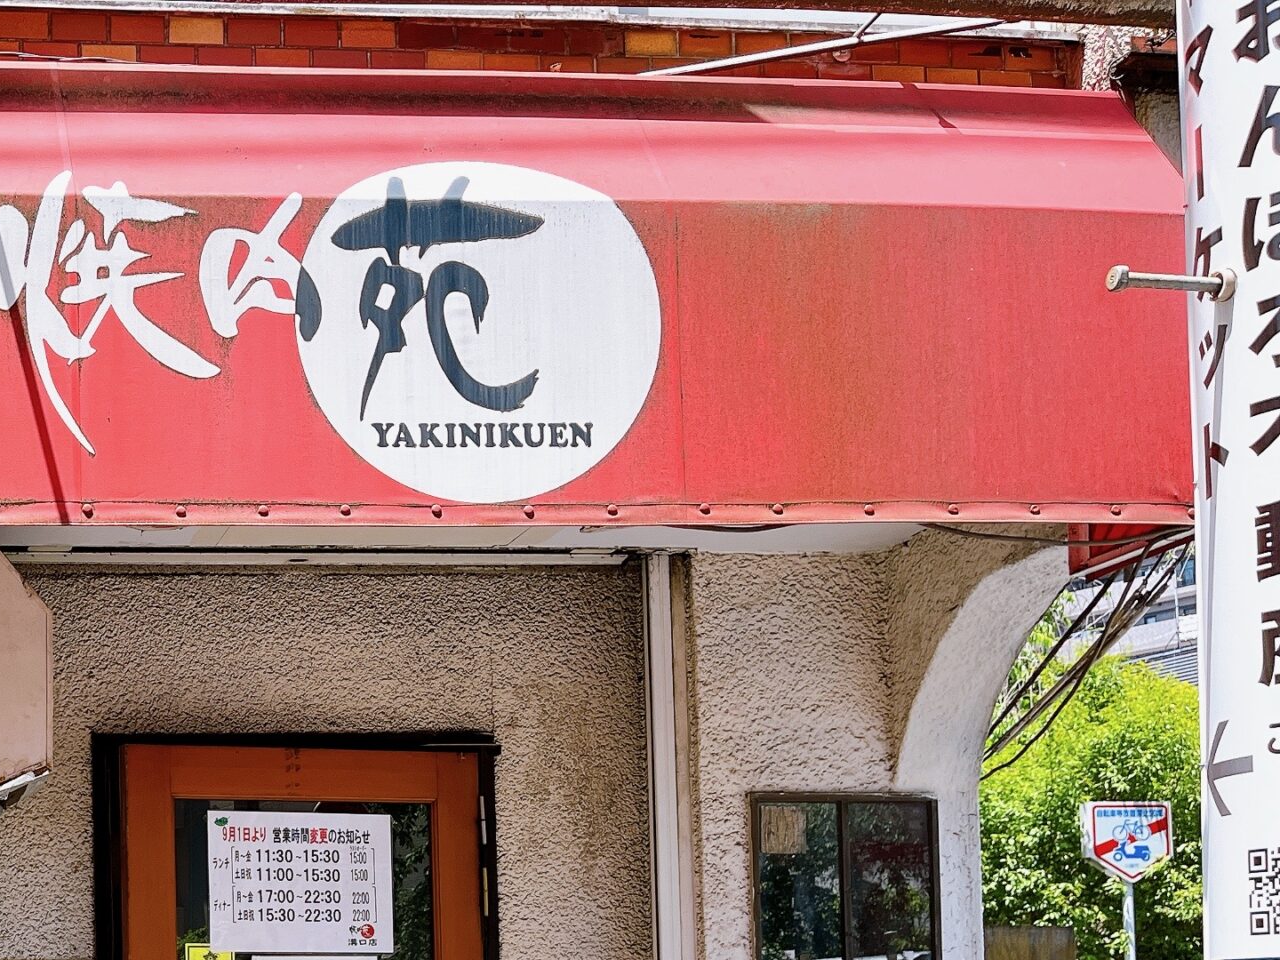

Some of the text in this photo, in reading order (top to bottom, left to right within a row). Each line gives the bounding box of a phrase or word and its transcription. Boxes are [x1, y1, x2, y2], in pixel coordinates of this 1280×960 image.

[374, 421, 592, 450] YAKINIKUEN
[222, 827, 370, 844] 9月1日より 営業時間変更のお知らせ
[212, 858, 230, 869] ランチ
[350, 852, 367, 864] 15:00
[235, 868, 252, 880] 土日祝
[351, 869, 368, 881] 15:00
[352, 892, 369, 904] 22:00
[238, 909, 254, 921] 土日祝
[353, 910, 370, 922] 22:00
[348, 939, 377, 947] 溝口店
